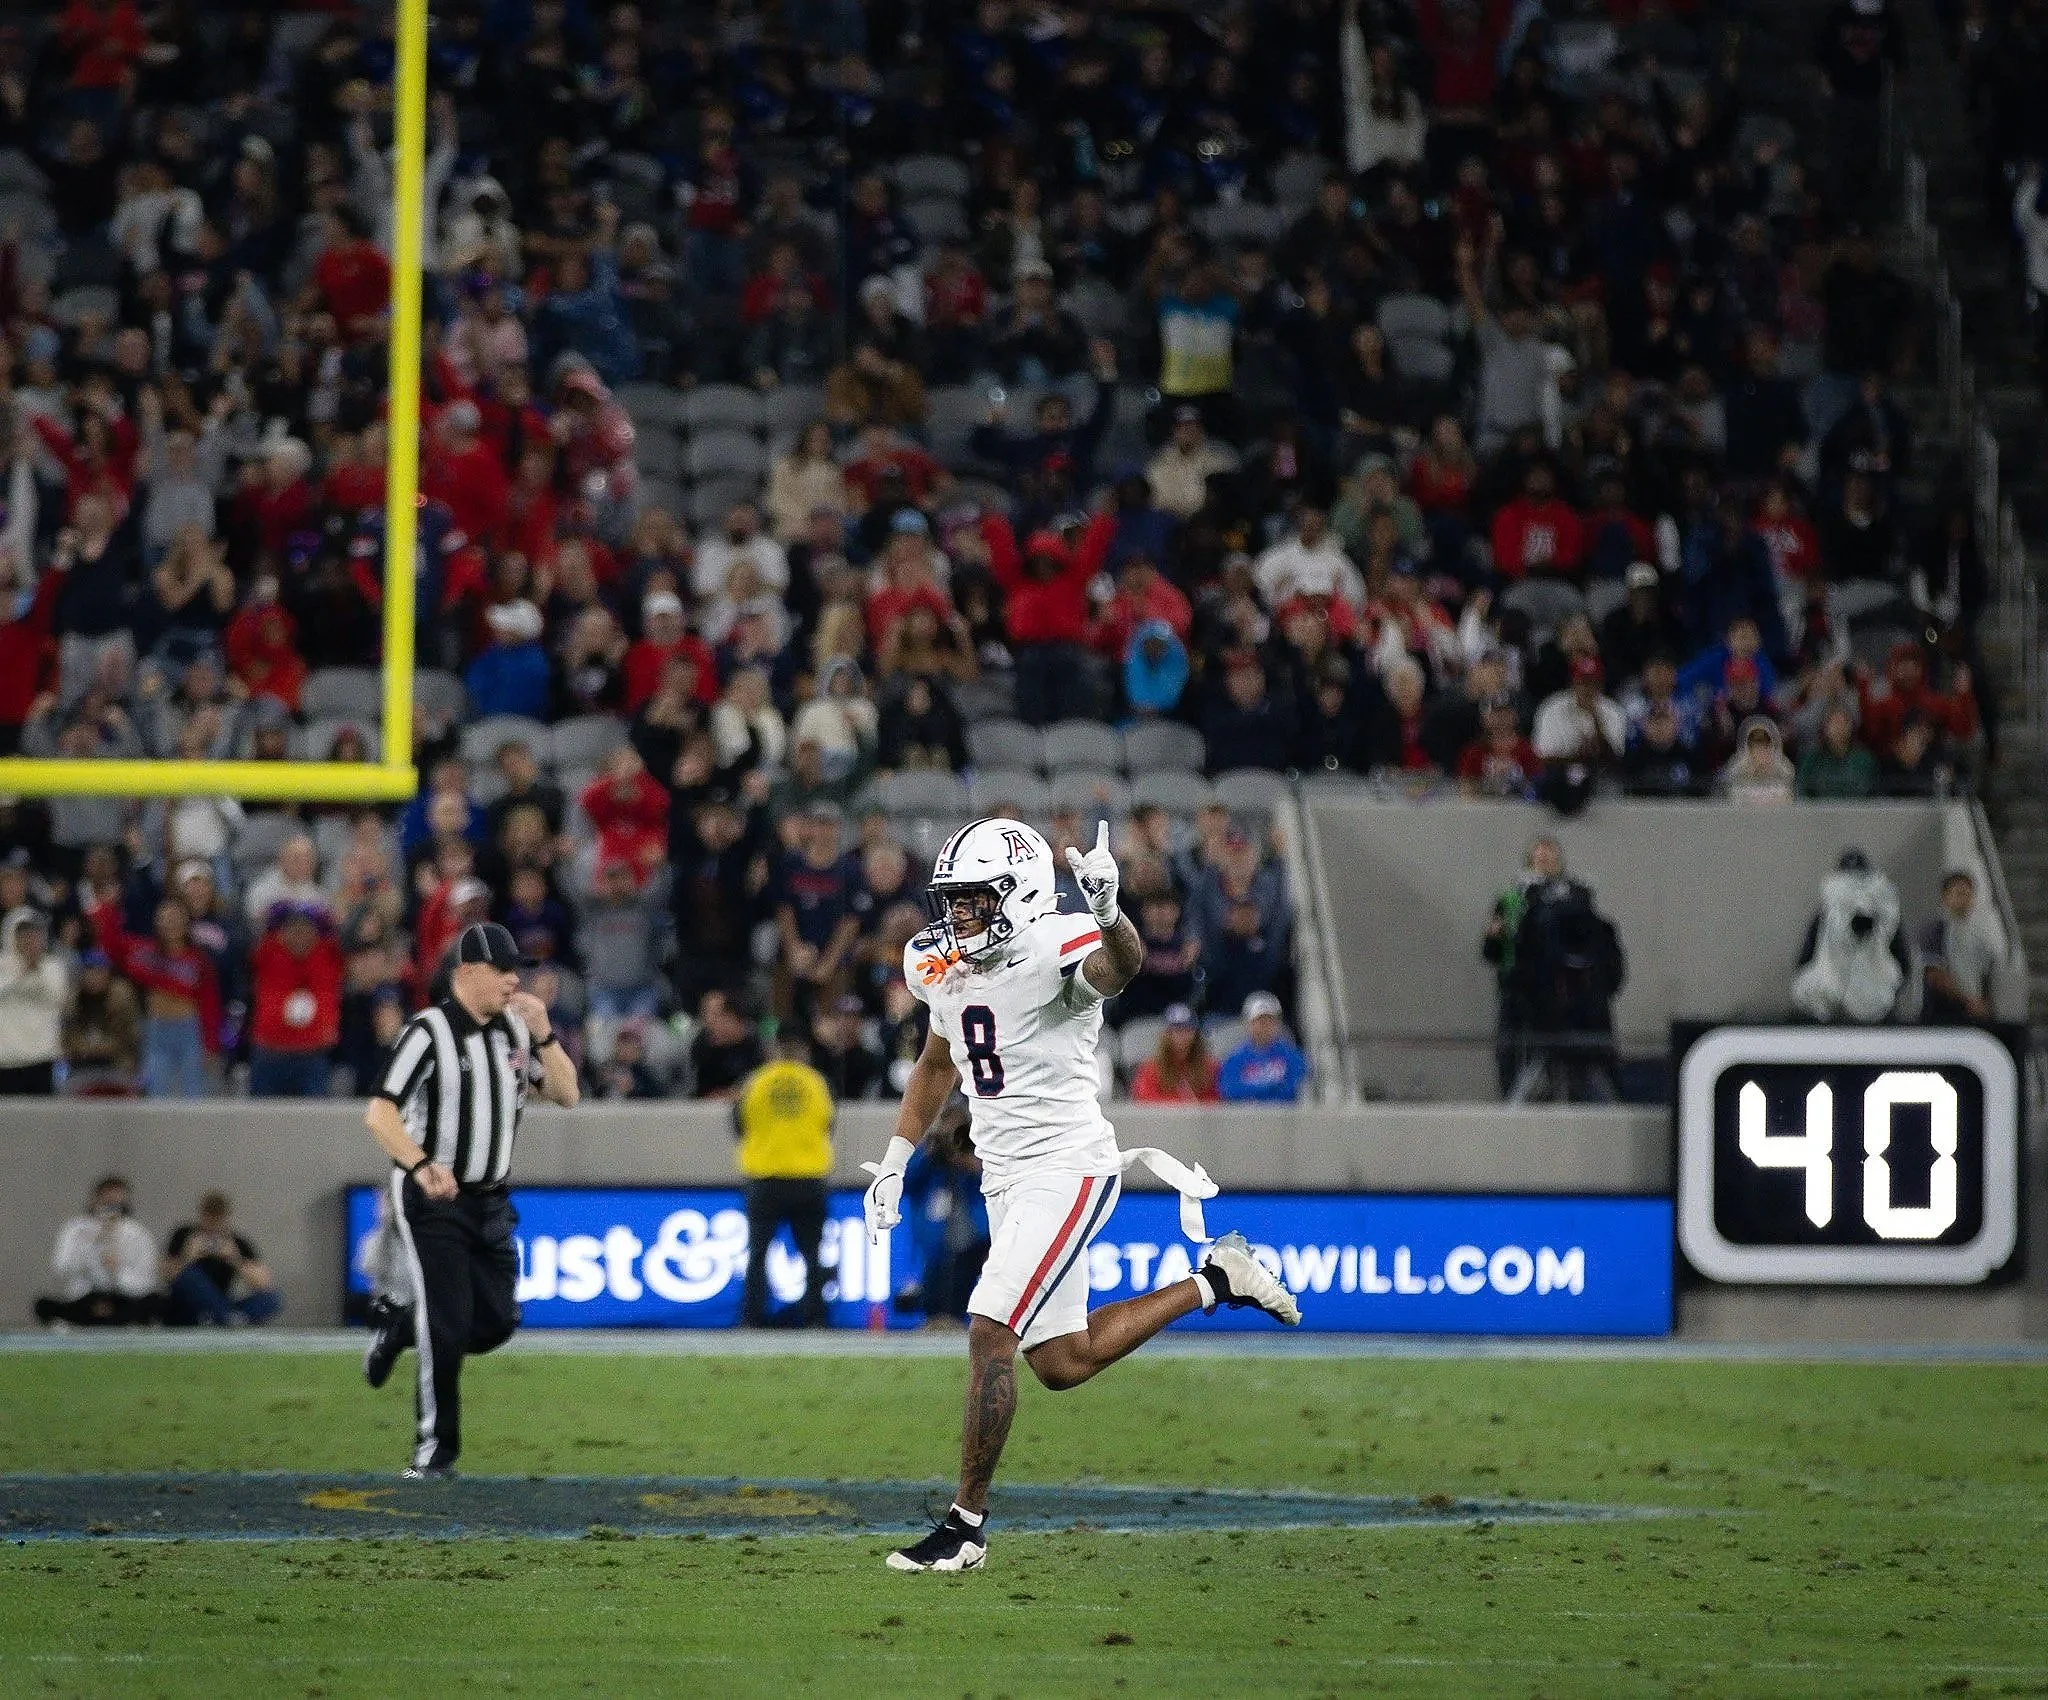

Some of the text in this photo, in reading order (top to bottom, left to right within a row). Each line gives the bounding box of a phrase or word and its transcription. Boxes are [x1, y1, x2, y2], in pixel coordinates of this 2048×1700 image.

[1001, 830, 1038, 865] A
[961, 1005, 1004, 1096] 8
[1739, 1071, 1957, 1239] 40
[1089, 1242, 1585, 1296] STADWILL.COM
